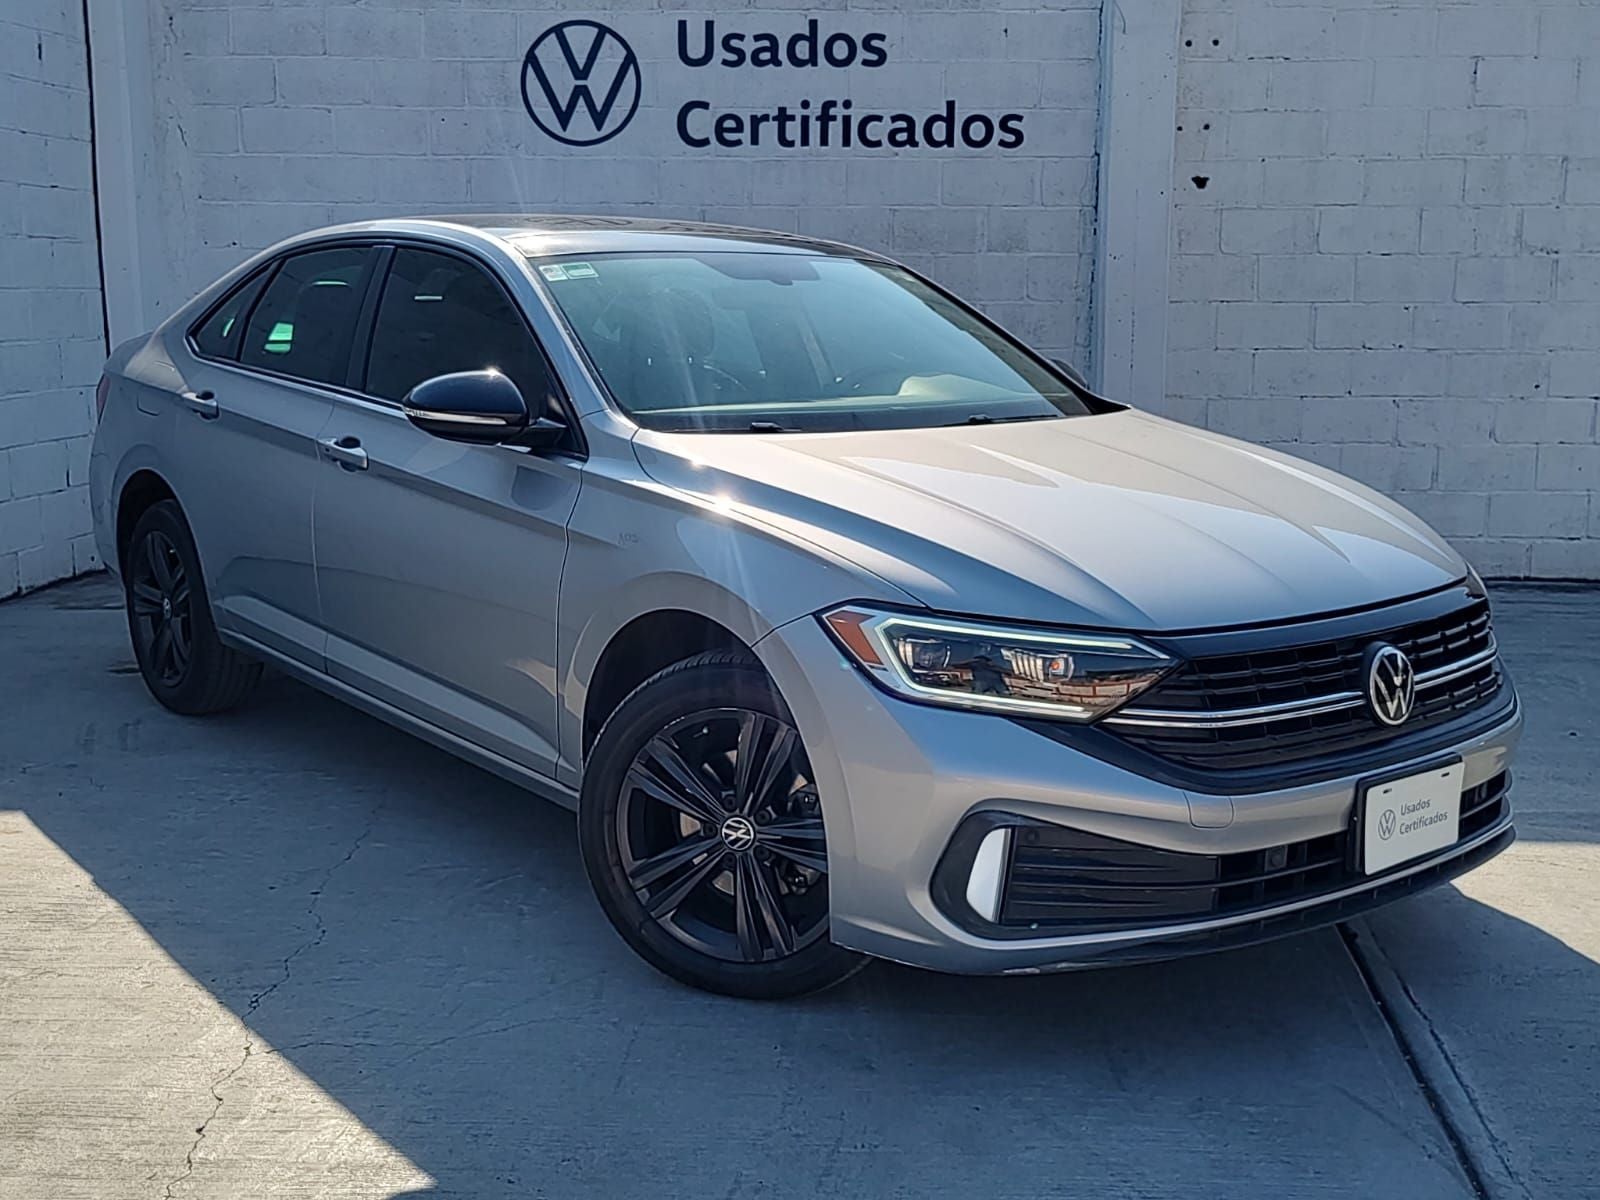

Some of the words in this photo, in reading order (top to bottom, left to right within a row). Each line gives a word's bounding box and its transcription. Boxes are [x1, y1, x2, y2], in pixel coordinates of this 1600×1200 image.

[676, 19, 888, 68] Usados
[676, 100, 1025, 149] Certificados
[1399, 811, 1448, 835] Certificados
[1400, 799, 1431, 816] Usados
